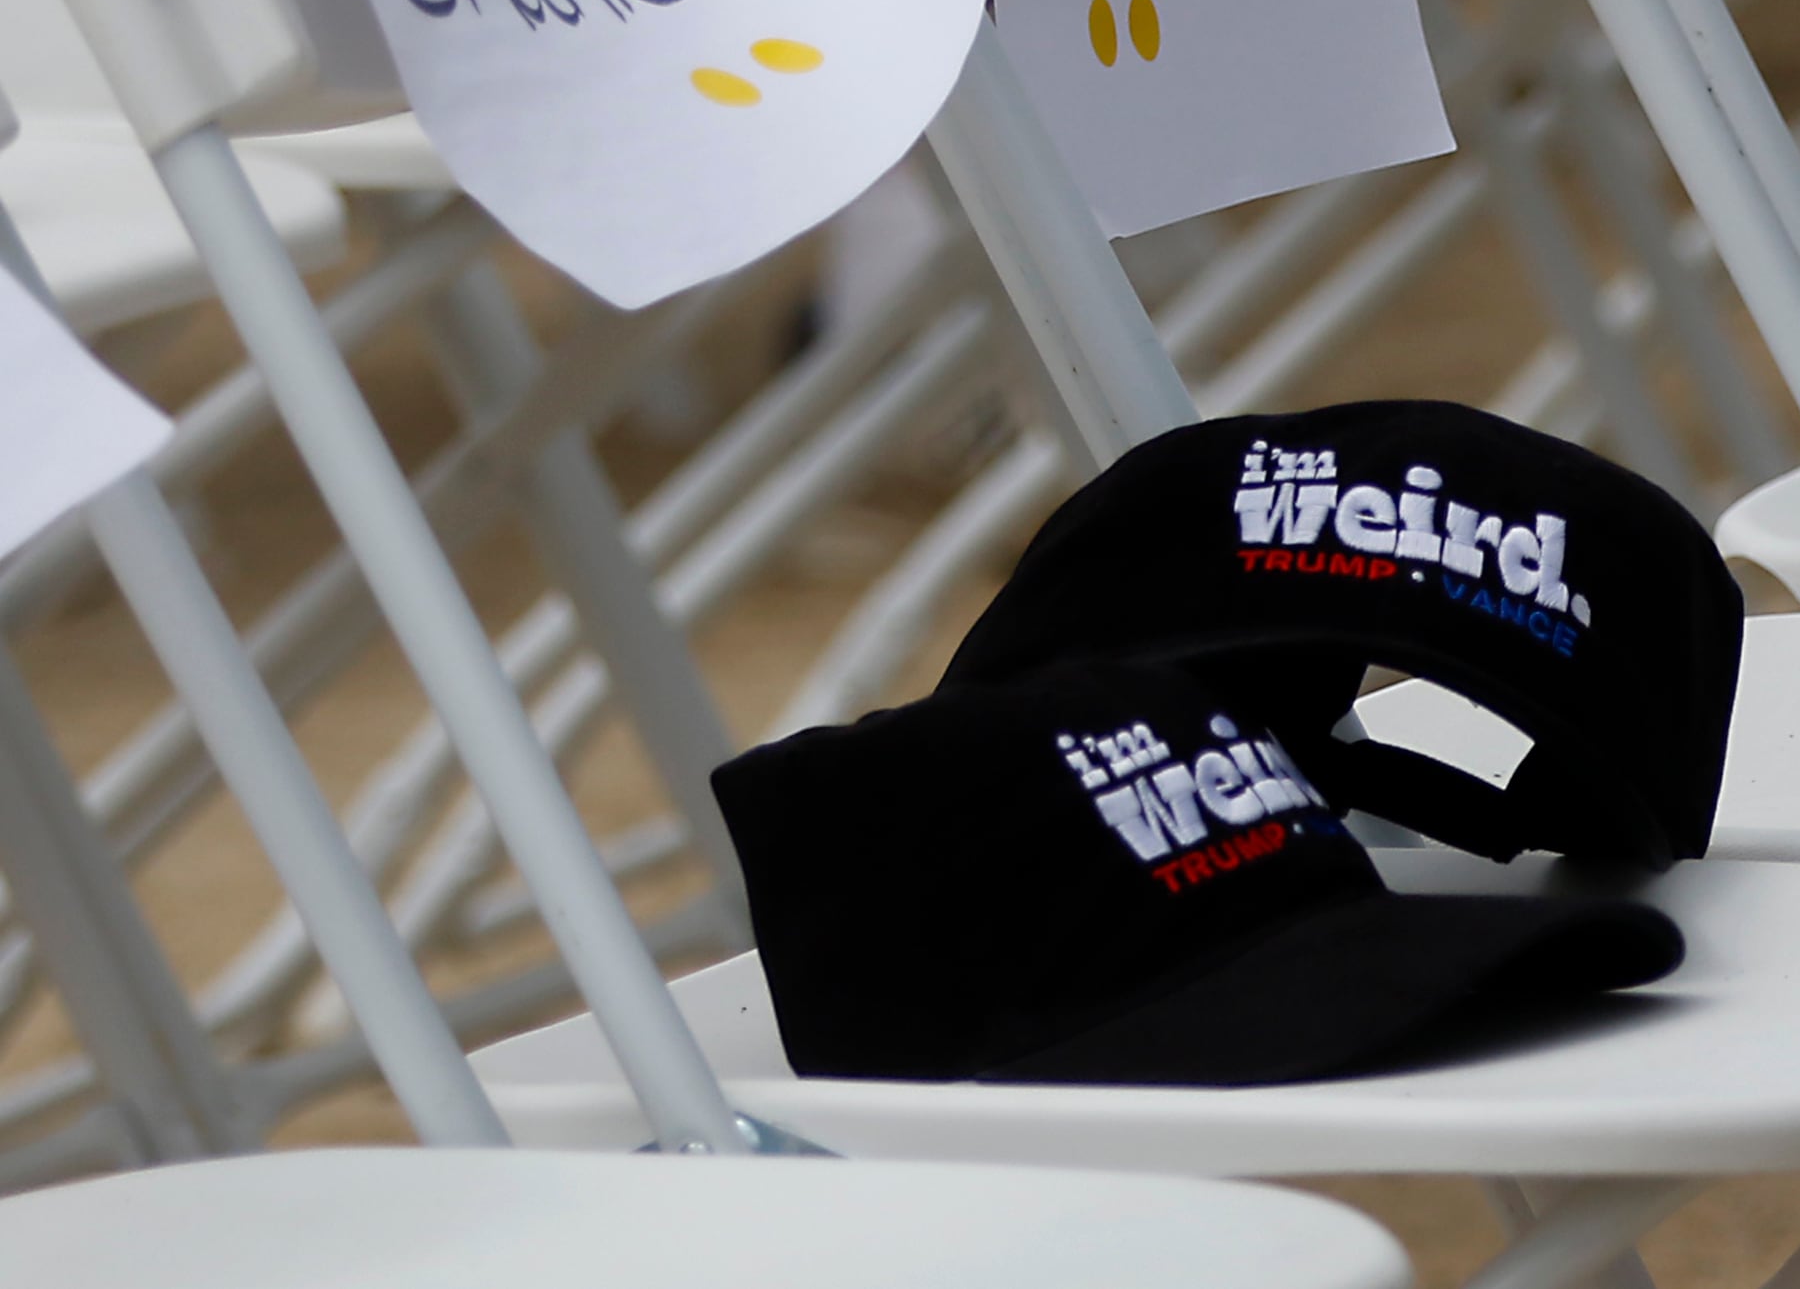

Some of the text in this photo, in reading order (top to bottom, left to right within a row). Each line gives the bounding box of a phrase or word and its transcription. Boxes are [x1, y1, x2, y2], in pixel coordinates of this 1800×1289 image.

[1241, 440, 1338, 484] i'm
[1236, 548, 1578, 658] TRUMP VANCE
[1057, 721, 1171, 790] i'm
[1152, 821, 1286, 893] TRUMP
